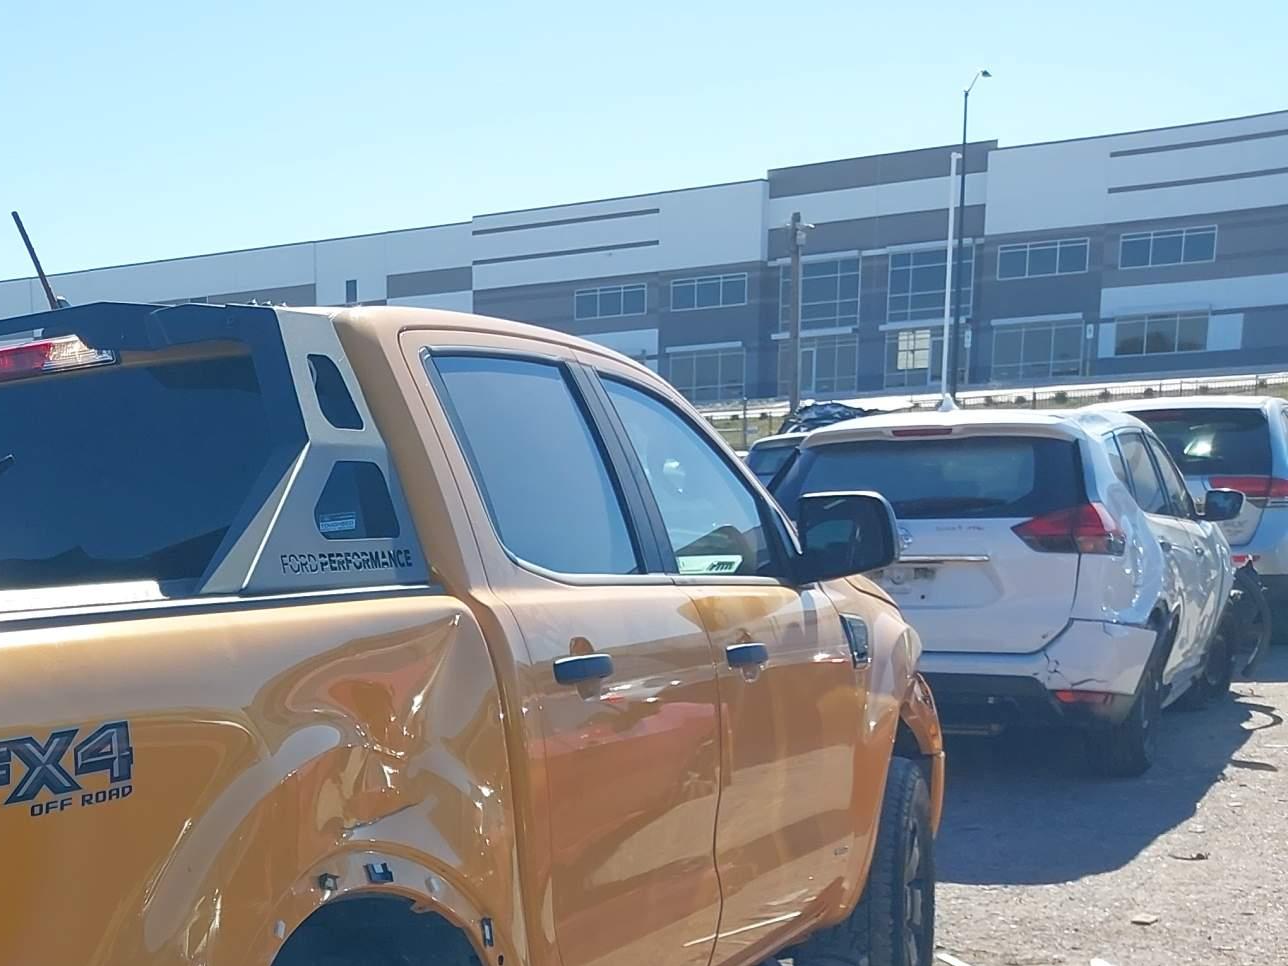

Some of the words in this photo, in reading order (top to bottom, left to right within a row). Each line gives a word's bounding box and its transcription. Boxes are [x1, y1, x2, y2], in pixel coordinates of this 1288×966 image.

[280, 553, 318, 574] FORD
[319, 549, 413, 572] PERFORMANCE
[30, 796, 73, 817] OFF
[81, 785, 133, 807] ROAD
